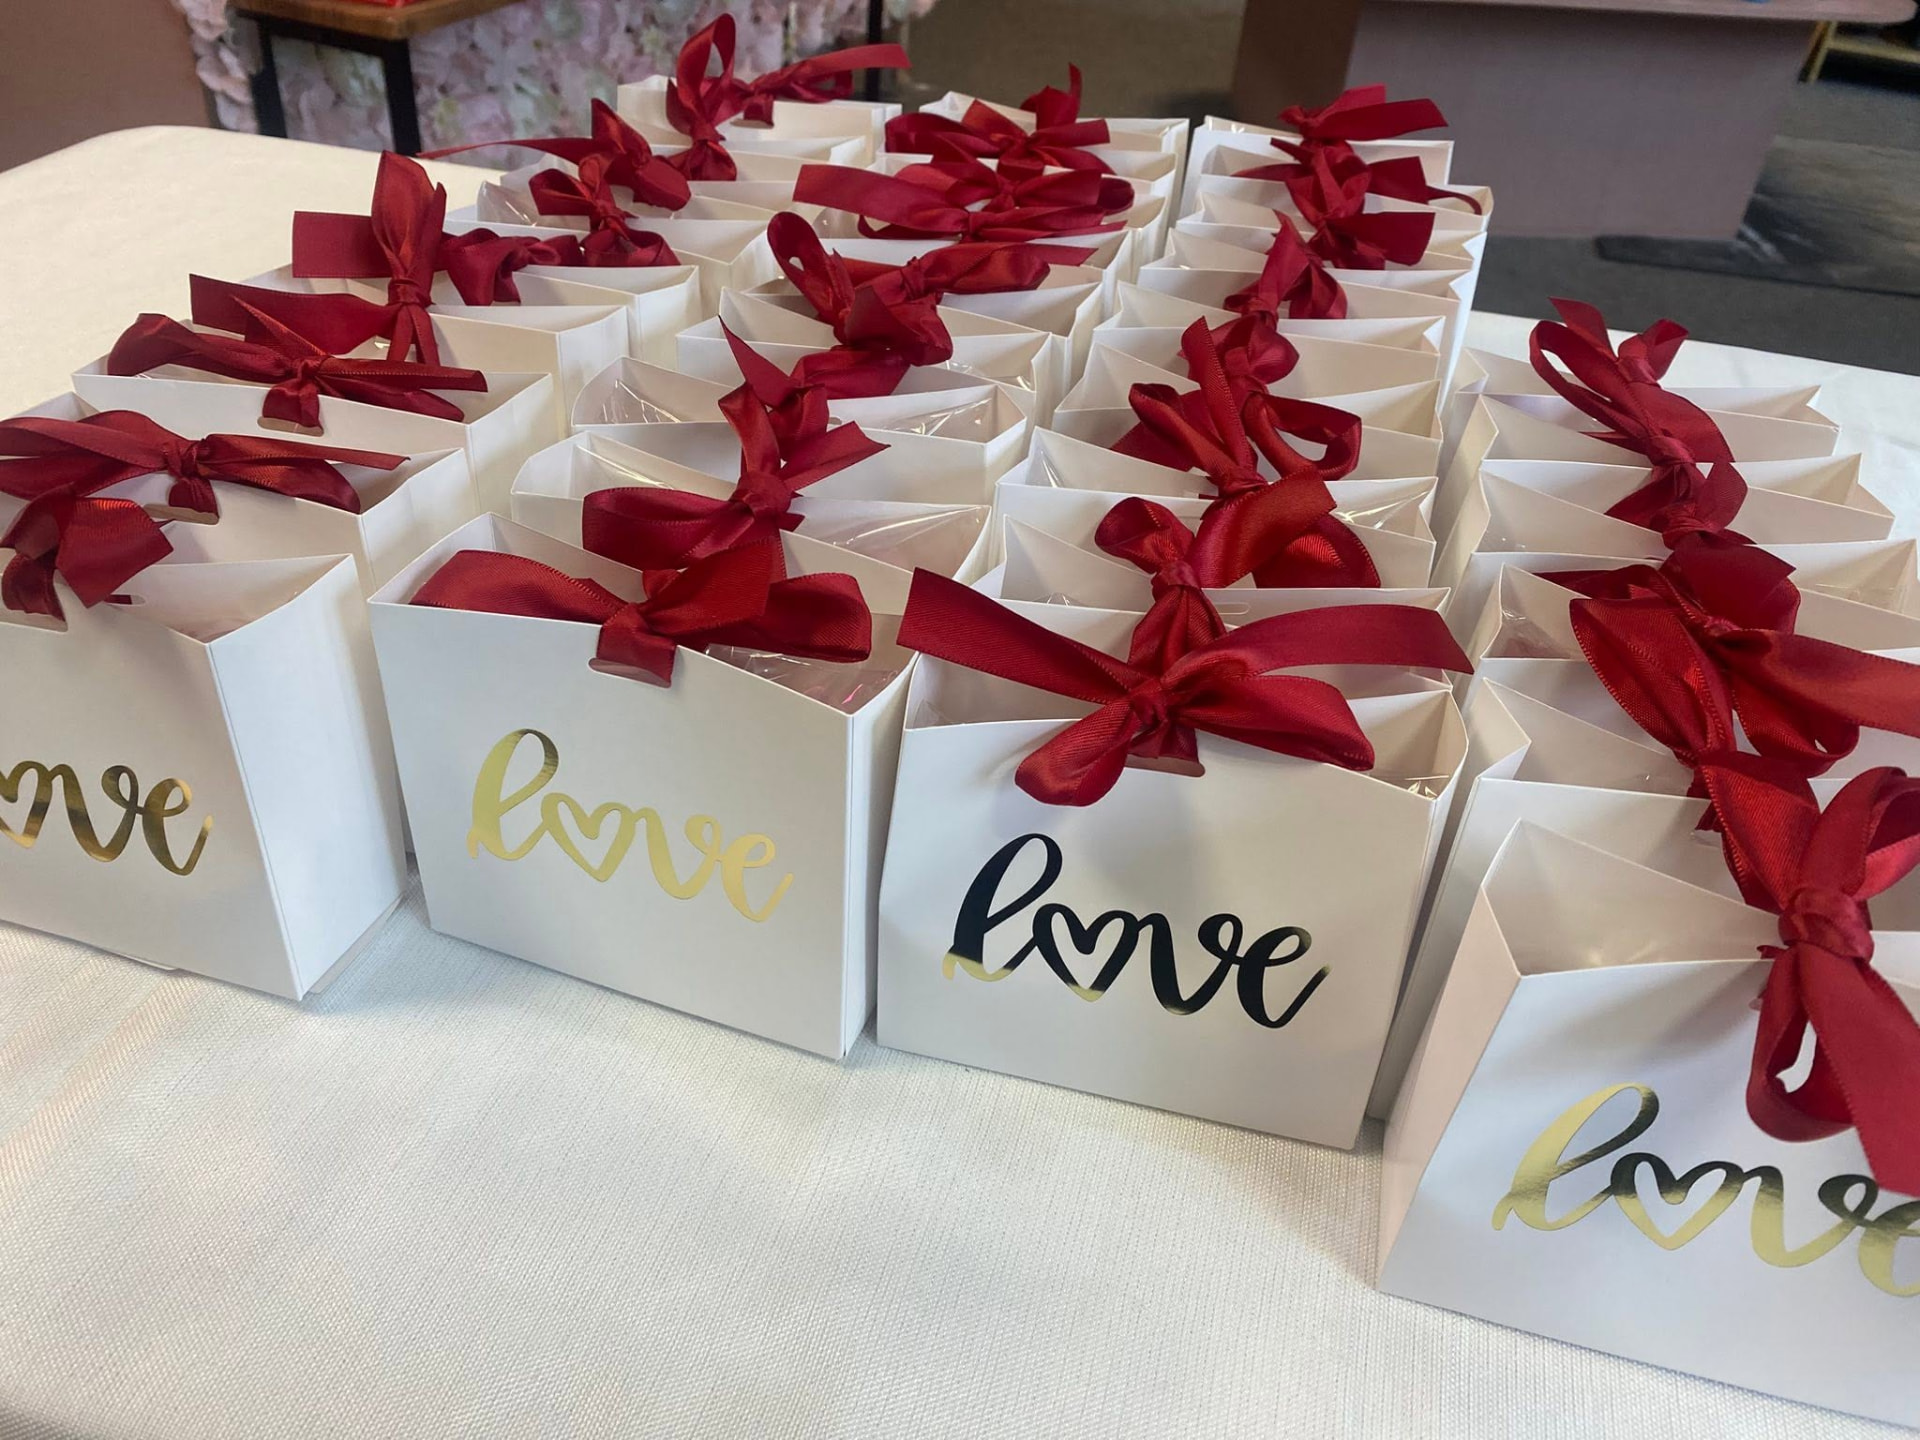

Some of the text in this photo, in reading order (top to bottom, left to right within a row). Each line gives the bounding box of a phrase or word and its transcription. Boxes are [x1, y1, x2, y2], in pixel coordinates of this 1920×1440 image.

[0, 760, 213, 876] ove
[466, 728, 794, 922] love
[942, 833, 1331, 1028] love
